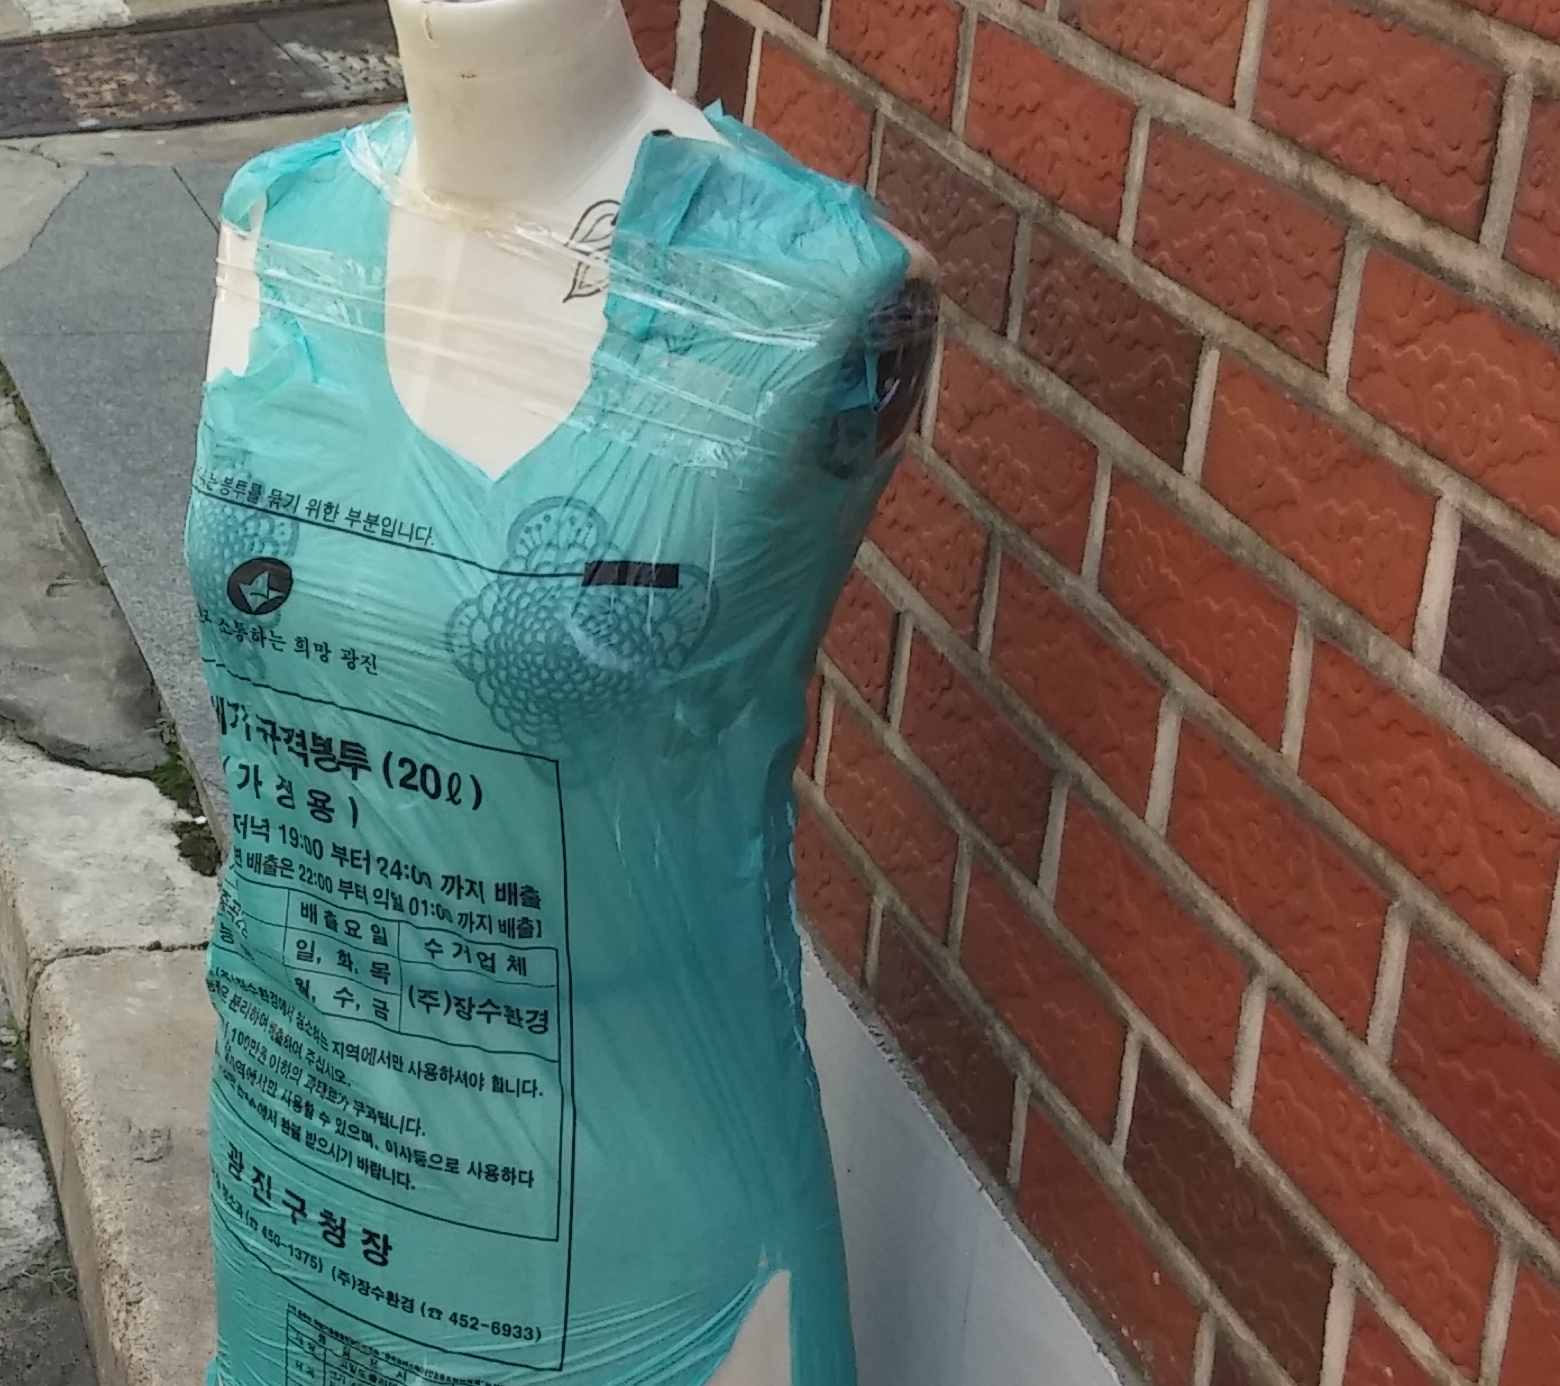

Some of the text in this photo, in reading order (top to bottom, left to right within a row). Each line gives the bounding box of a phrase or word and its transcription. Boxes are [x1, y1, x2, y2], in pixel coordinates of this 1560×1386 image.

[268, 487, 301, 514] 묶기
[305, 497, 341, 524] 위한
[344, 506, 435, 547] 부분입니다.
[294, 635, 332, 663] 희망
[340, 647, 378, 676] 광진
[233, 812, 270, 844] 저녁
[278, 823, 324, 861] 19:00
[331, 842, 371, 876] 부터
[440, 874, 485, 905] 까지
[495, 881, 542, 910] 배출
[247, 852, 295, 880] 배출은
[298, 863, 333, 894] 22:00
[338, 878, 369, 905] 부터
[457, 911, 493, 935] 까지
[269, 1054, 304, 1087] 이하의
[332, 1039, 405, 1074] 지역에서만
[407, 1059, 486, 1093] 사용하셔야
[491, 1074, 544, 1099] 합니다.
[305, 1130, 353, 1168] 받으시기
[356, 1155, 416, 1191] 바랍니다.
[319, 1110, 331, 1128] 수
[466, 1160, 535, 1190] 사용하다
